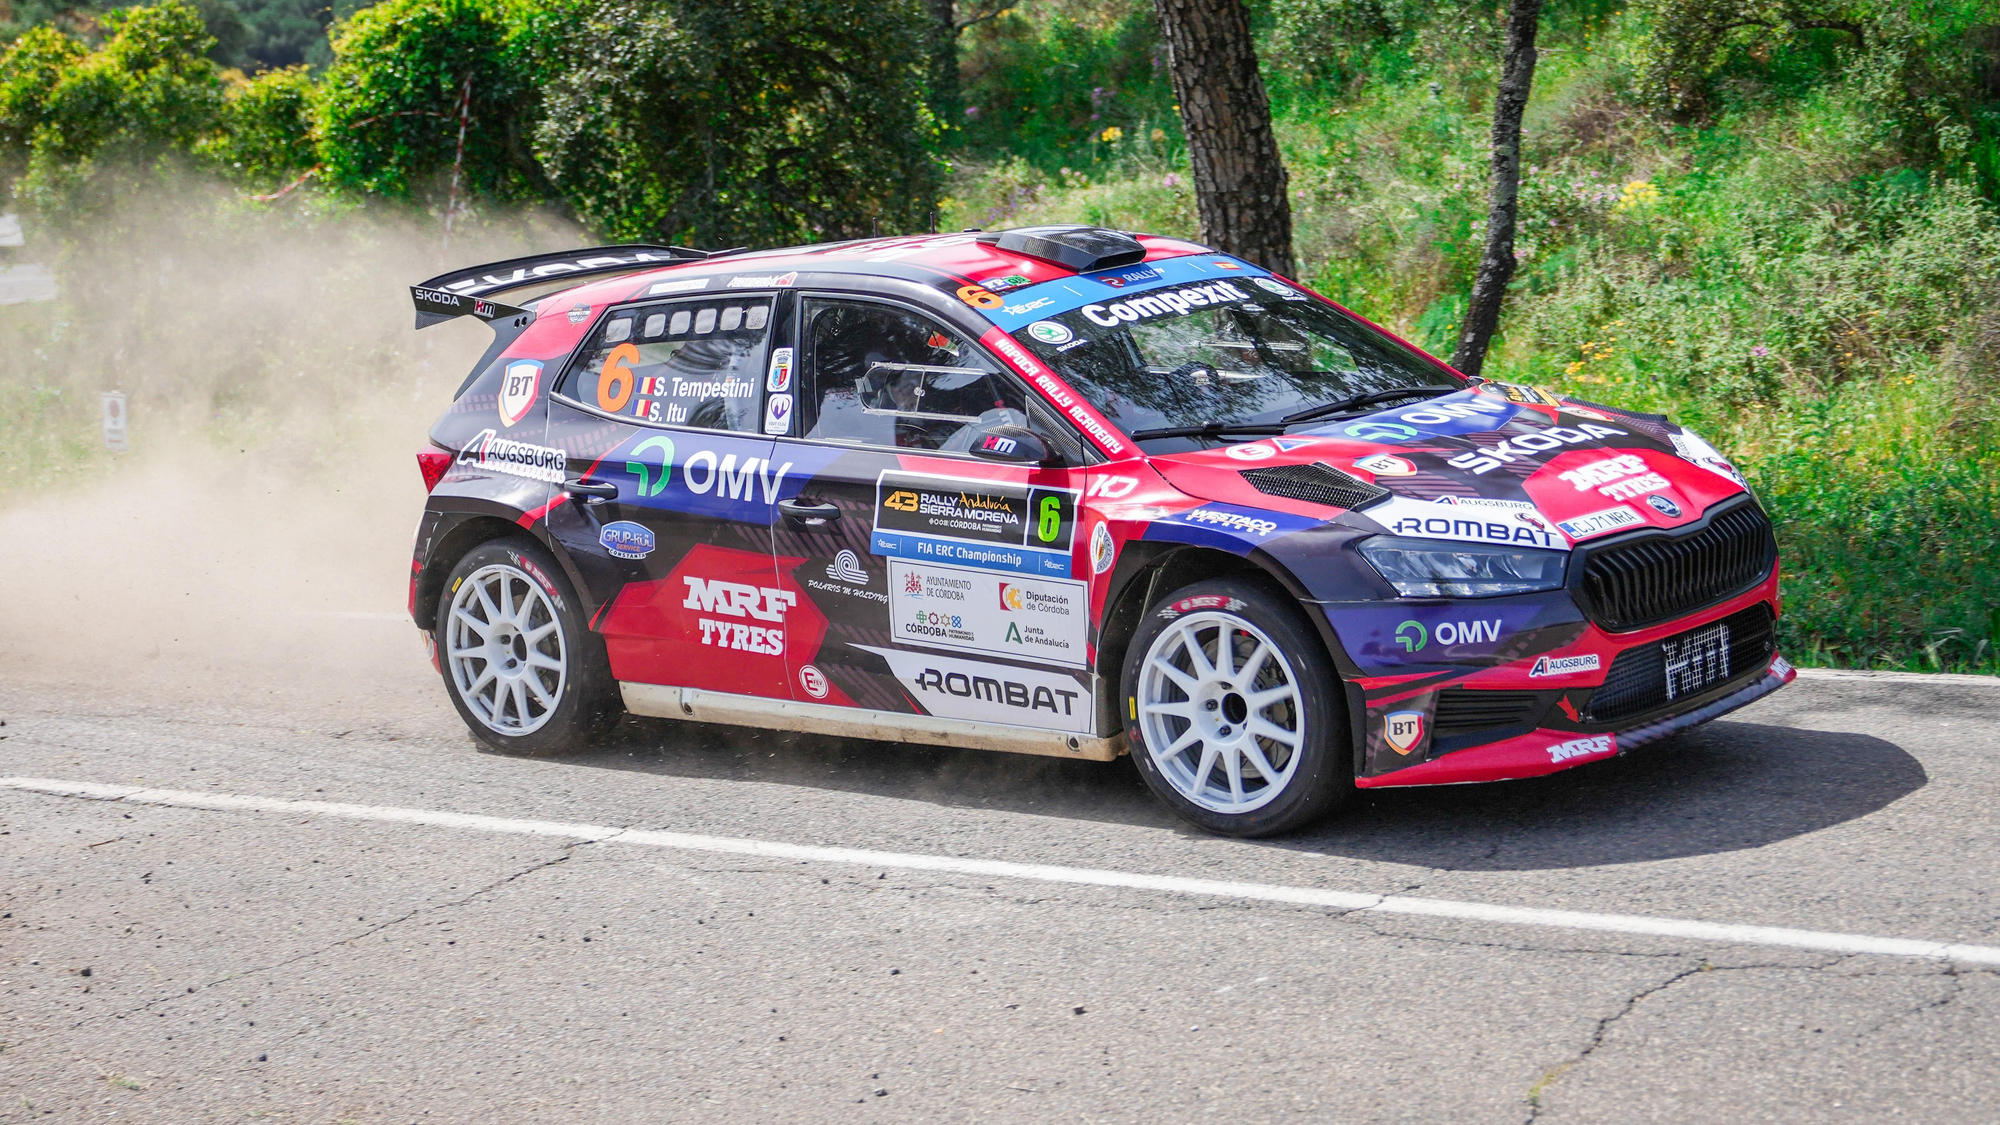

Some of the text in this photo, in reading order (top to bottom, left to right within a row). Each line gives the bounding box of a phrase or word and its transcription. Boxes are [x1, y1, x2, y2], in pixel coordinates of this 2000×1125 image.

[1123, 270, 1158, 286] RALLY
[415, 289, 460, 307] SKODA
[956, 285, 1004, 310] 6
[1081, 281, 1250, 327] Compexit
[1056, 339, 1087, 352] SKODA
[509, 374, 533, 397] BT
[597, 343, 641, 412] 6
[653, 377, 754, 403] S. Tempestini
[995, 339, 1124, 454] NAPOCA RALLY ACADEMY
[648, 402, 687, 422] S. Itu
[1400, 398, 1506, 425] OMV
[488, 440, 564, 471] AUGSBURG
[1448, 422, 1629, 475] SKODA
[487, 460, 563, 480] INTERNATIONAL
[1369, 457, 1398, 471] BT
[1558, 454, 1649, 491] MRF
[683, 450, 794, 505] OMV
[1599, 472, 1671, 501] TYRES
[884, 490, 918, 512] 43
[920, 490, 1012, 513] RALLY Andalucía
[1460, 498, 1533, 511] AUGSBURG
[919, 505, 1019, 524] SIERRA MORENA
[950, 519, 981, 531] CÓRDOBA
[1037, 496, 1061, 542] 6
[1192, 509, 1277, 531] WESTACO
[1573, 510, 1637, 533] CJ 71 NRA
[1392, 517, 1557, 547] ROMBAT
[616, 543, 640, 552] SERVICE
[917, 542, 1022, 567] FIA ERC Championship
[808, 580, 888, 604] POLARIS M HOLDING
[926, 576, 971, 591] AYUNTAMIENTO
[926, 587, 965, 601] DE CÓRDOBA
[683, 576, 796, 623] MRF
[1026, 590, 1069, 605] Diputación
[1026, 601, 1070, 616] de Córdoba
[699, 618, 783, 656] TYRES
[906, 623, 947, 638] CÓRDOBA
[1024, 625, 1044, 636] Junta
[1024, 635, 1070, 649] de Andalucía
[1435, 619, 1501, 646] OMV
[1550, 655, 1597, 670] AUGSBURG
[915, 668, 1078, 716] ROMBAT
[1392, 721, 1416, 735] BT
[1547, 735, 1612, 763] MRF
